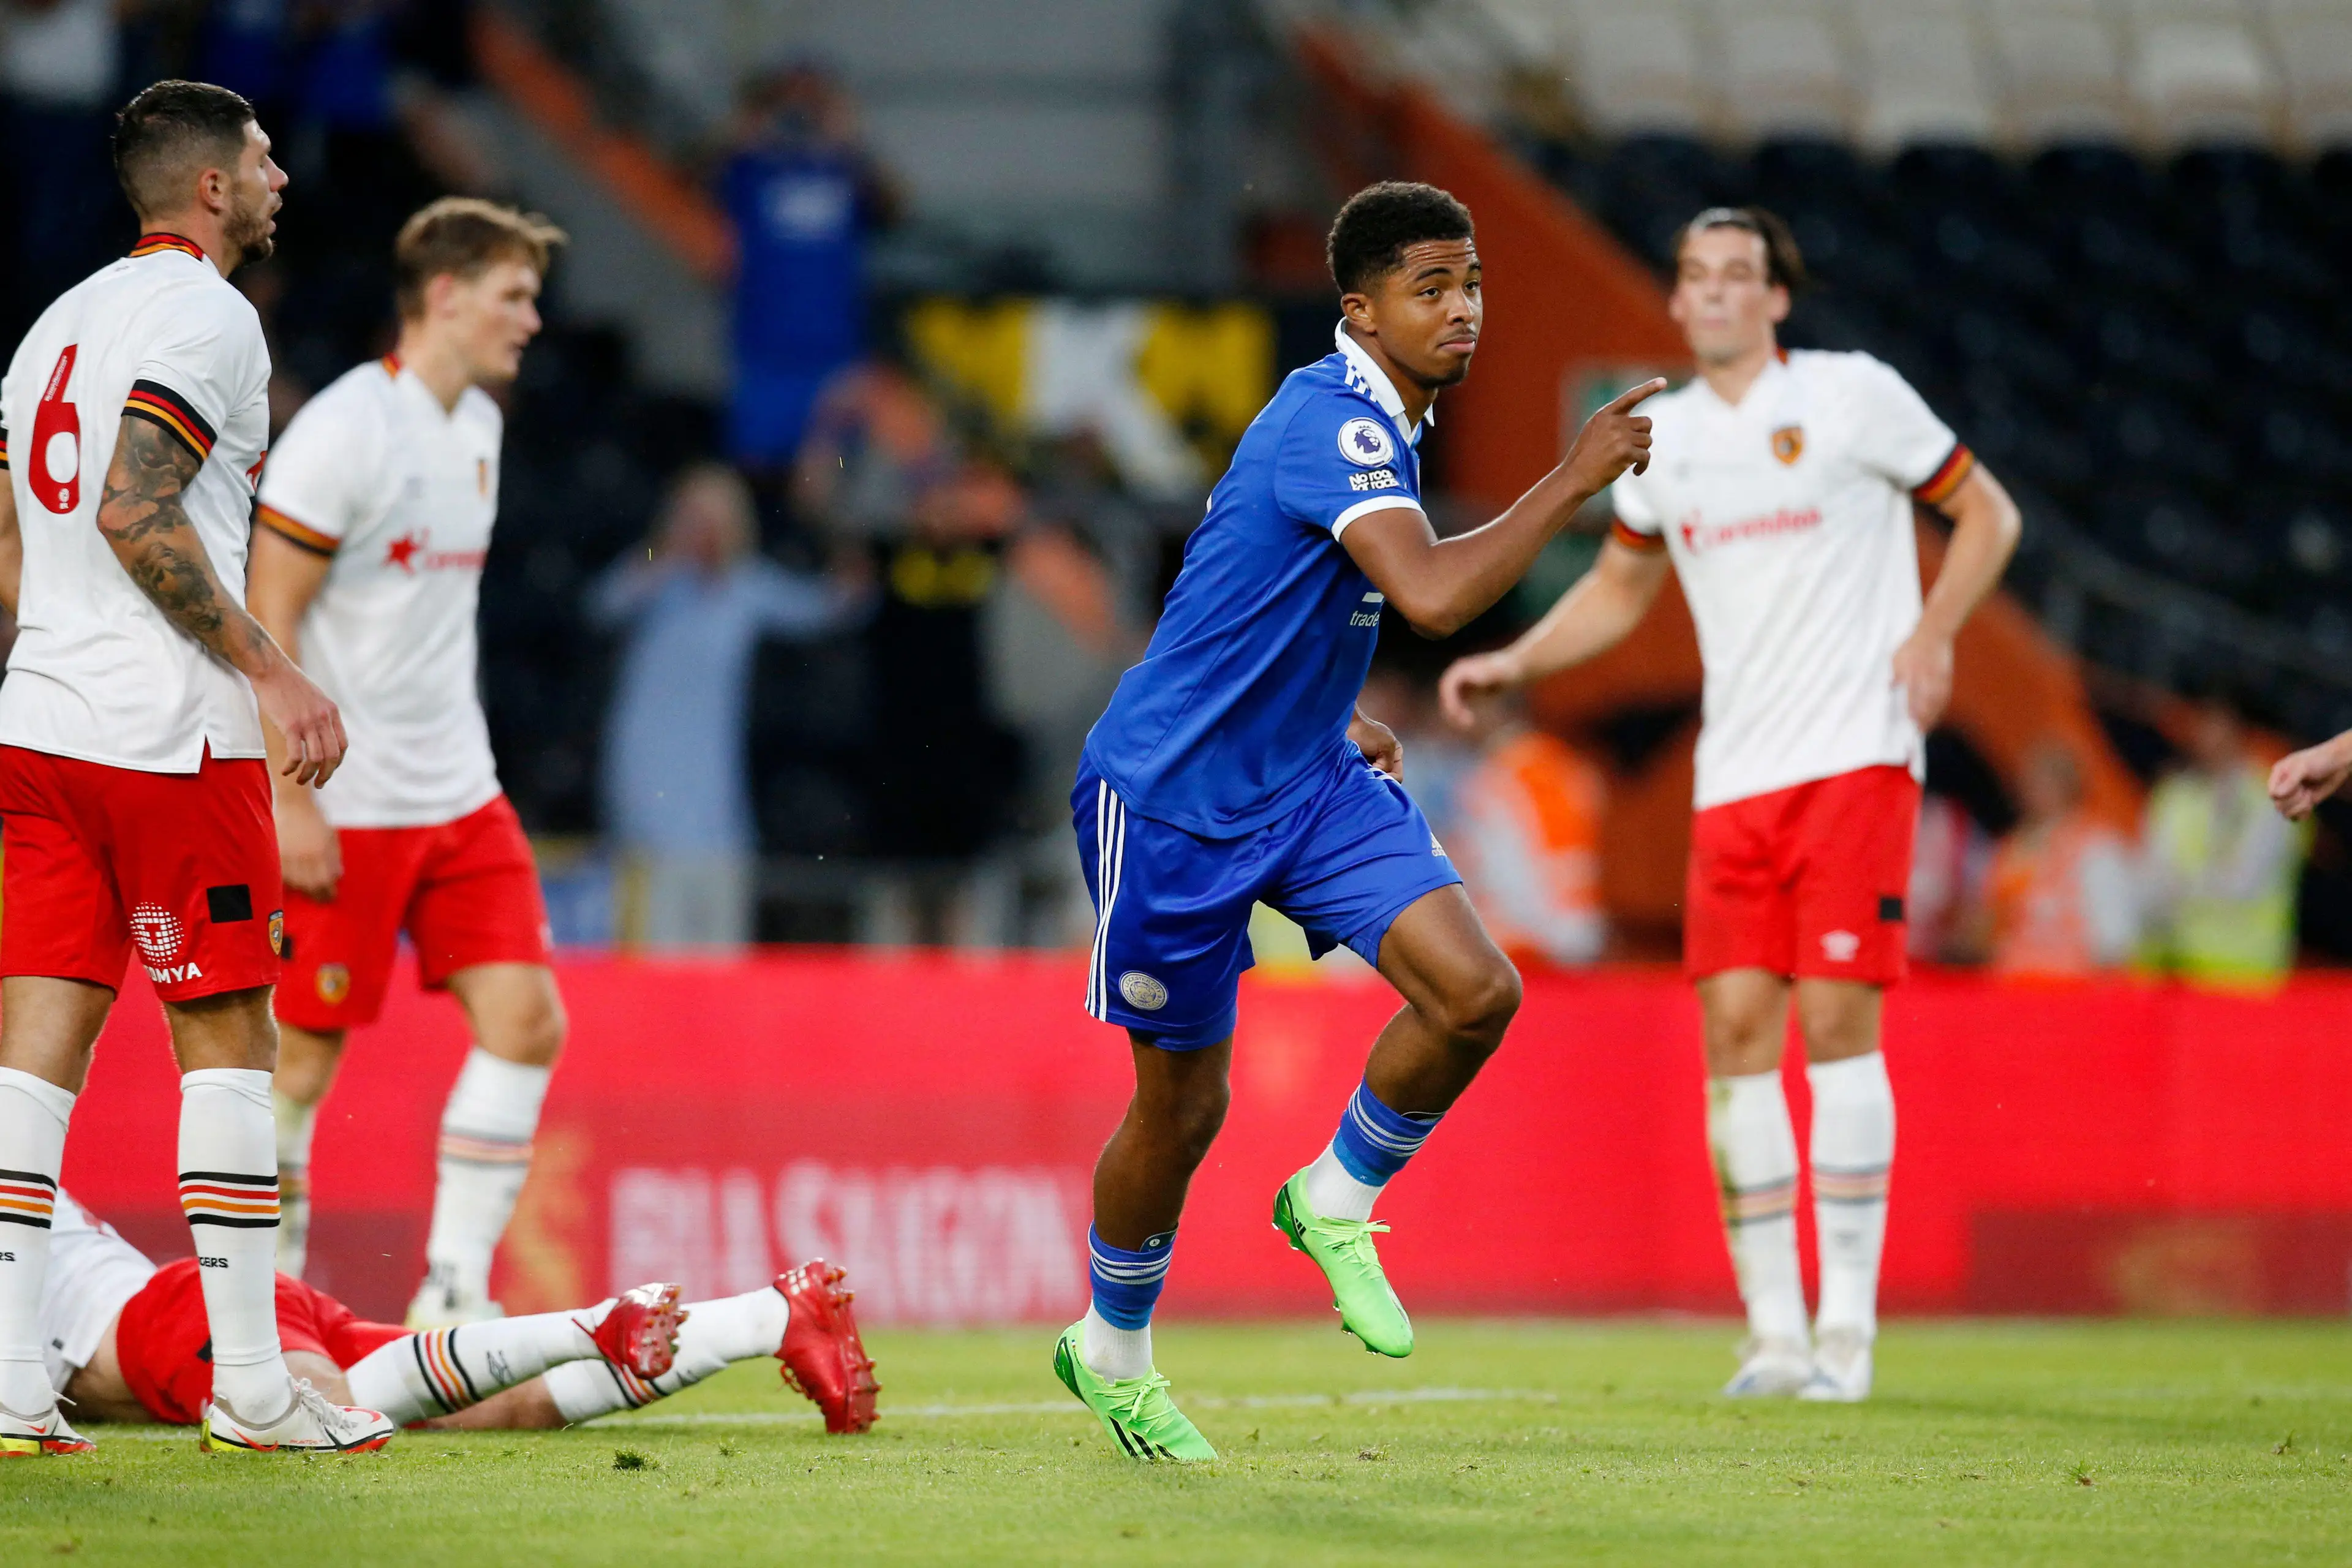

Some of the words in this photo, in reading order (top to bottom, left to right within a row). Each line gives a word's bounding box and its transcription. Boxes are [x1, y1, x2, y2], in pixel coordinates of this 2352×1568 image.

[29, 344, 80, 514] 6
[1349, 473, 1368, 484] No
[1349, 610, 1380, 627] trade
